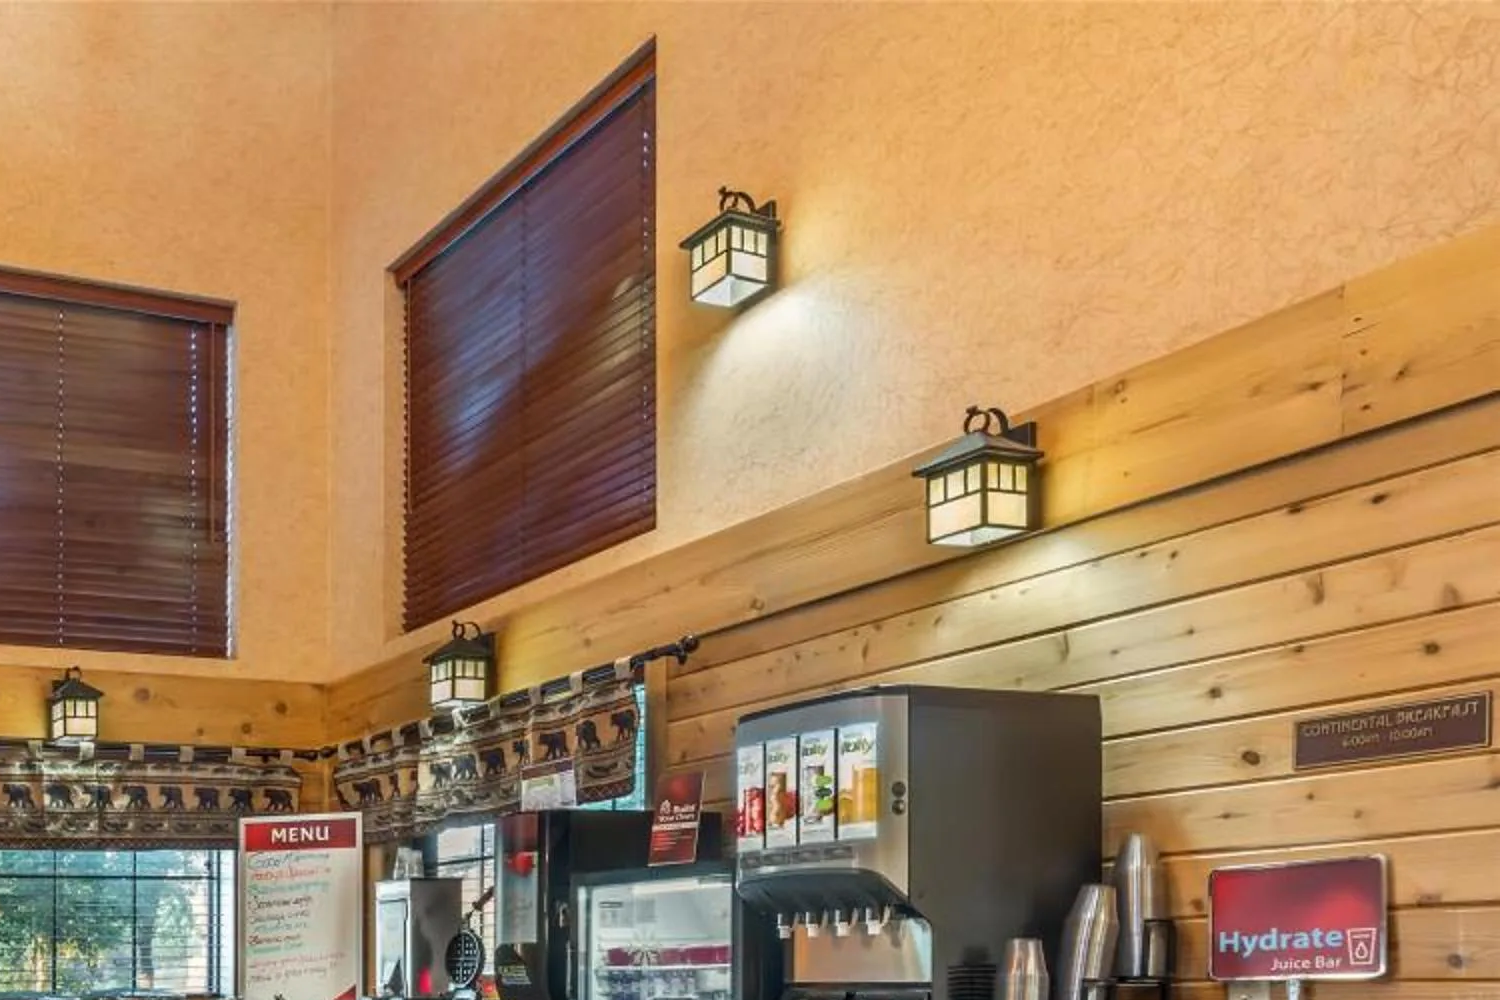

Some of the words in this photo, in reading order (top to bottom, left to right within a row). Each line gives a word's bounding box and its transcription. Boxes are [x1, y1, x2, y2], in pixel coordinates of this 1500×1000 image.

[1302, 714, 1392, 738] CONTINENTAL
[1397, 701, 1479, 723] BREAKFAST
[271, 825, 329, 844] MENU
[1219, 928, 1344, 958] Hydrate
[1271, 957, 1312, 972] Juice
[1315, 955, 1342, 969] Bar
